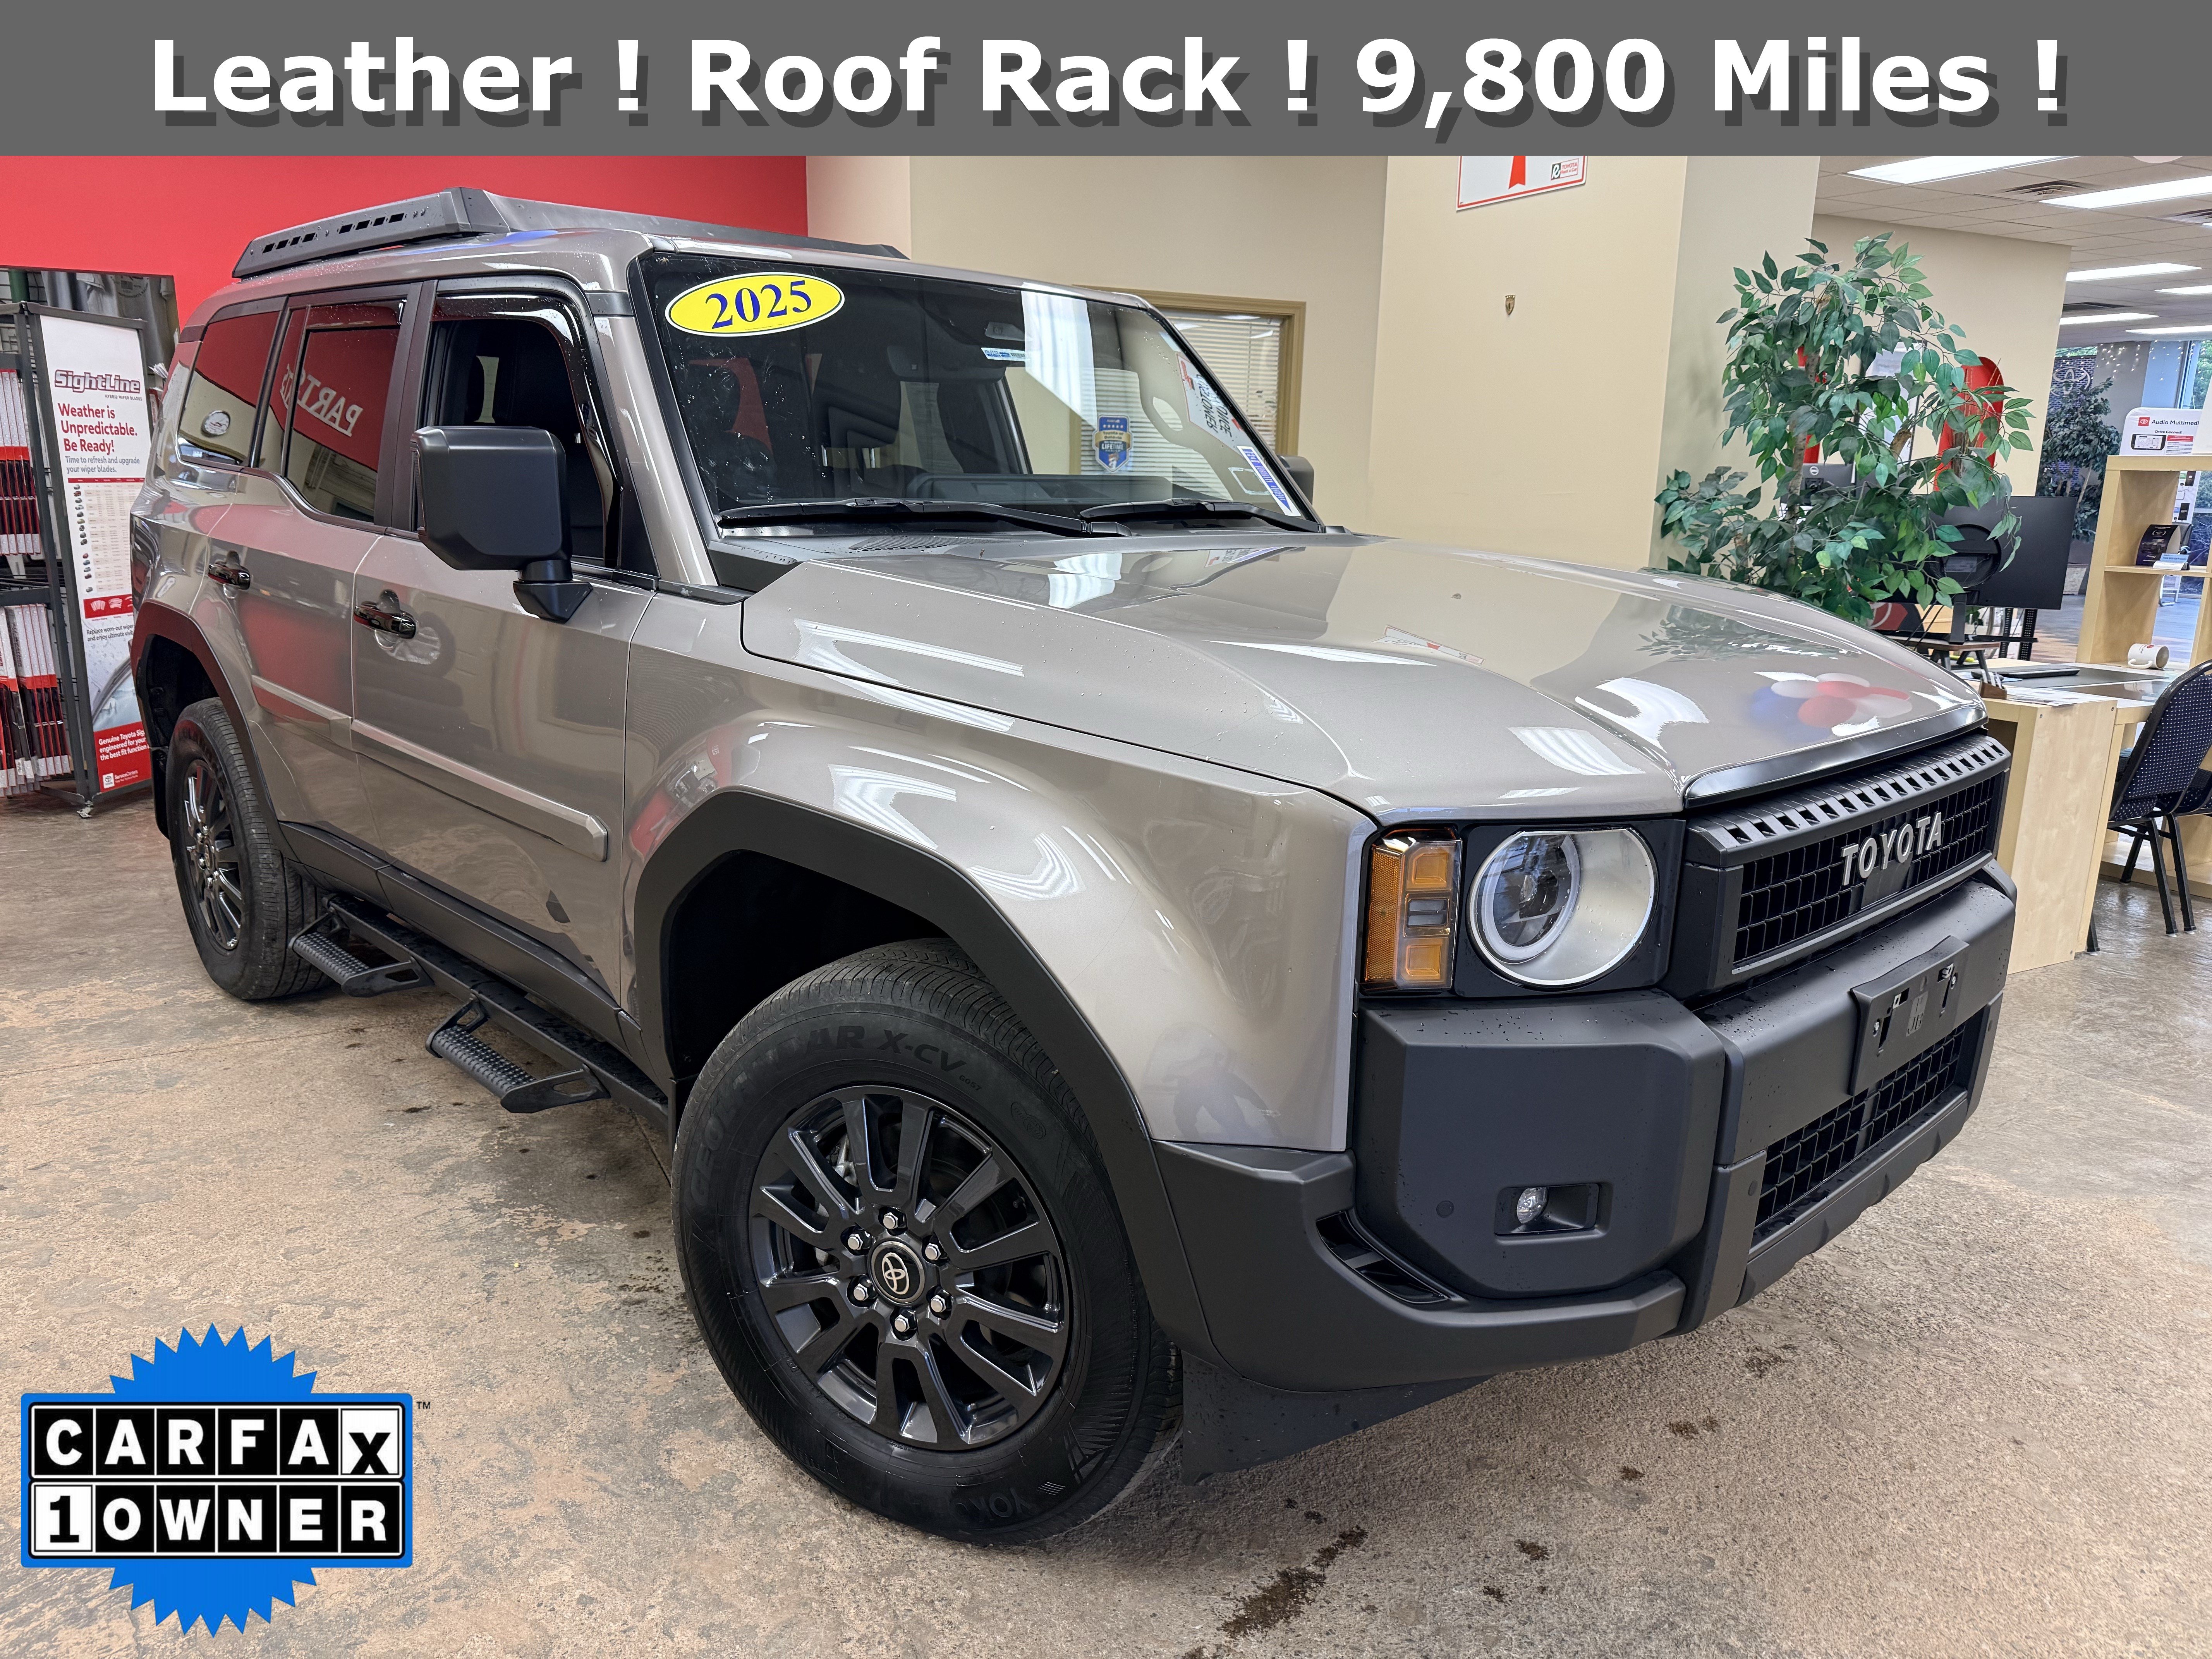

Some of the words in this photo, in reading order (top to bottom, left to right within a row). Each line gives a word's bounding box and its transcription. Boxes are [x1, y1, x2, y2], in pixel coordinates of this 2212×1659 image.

[705, 280, 812, 329] 2025
[55, 369, 140, 393] SightLine
[58, 403, 105, 418] Weather
[107, 405, 115, 419] is
[61, 420, 137, 437] Unpredictable.
[64, 438, 77, 451] Be
[80, 439, 115, 455] Ready!
[118, 457, 140, 465] upgrade
[81, 465, 96, 474] wiper
[98, 735, 120, 745] Genuine
[120, 732, 136, 740] Toyota
[99, 740, 127, 753] engineered
[135, 737, 146, 745] your
[110, 750, 121, 759] best
[127, 744, 147, 754] function
[1841, 812, 1942, 886] TOYOTA
[877, 1028, 967, 1072] X-CV
